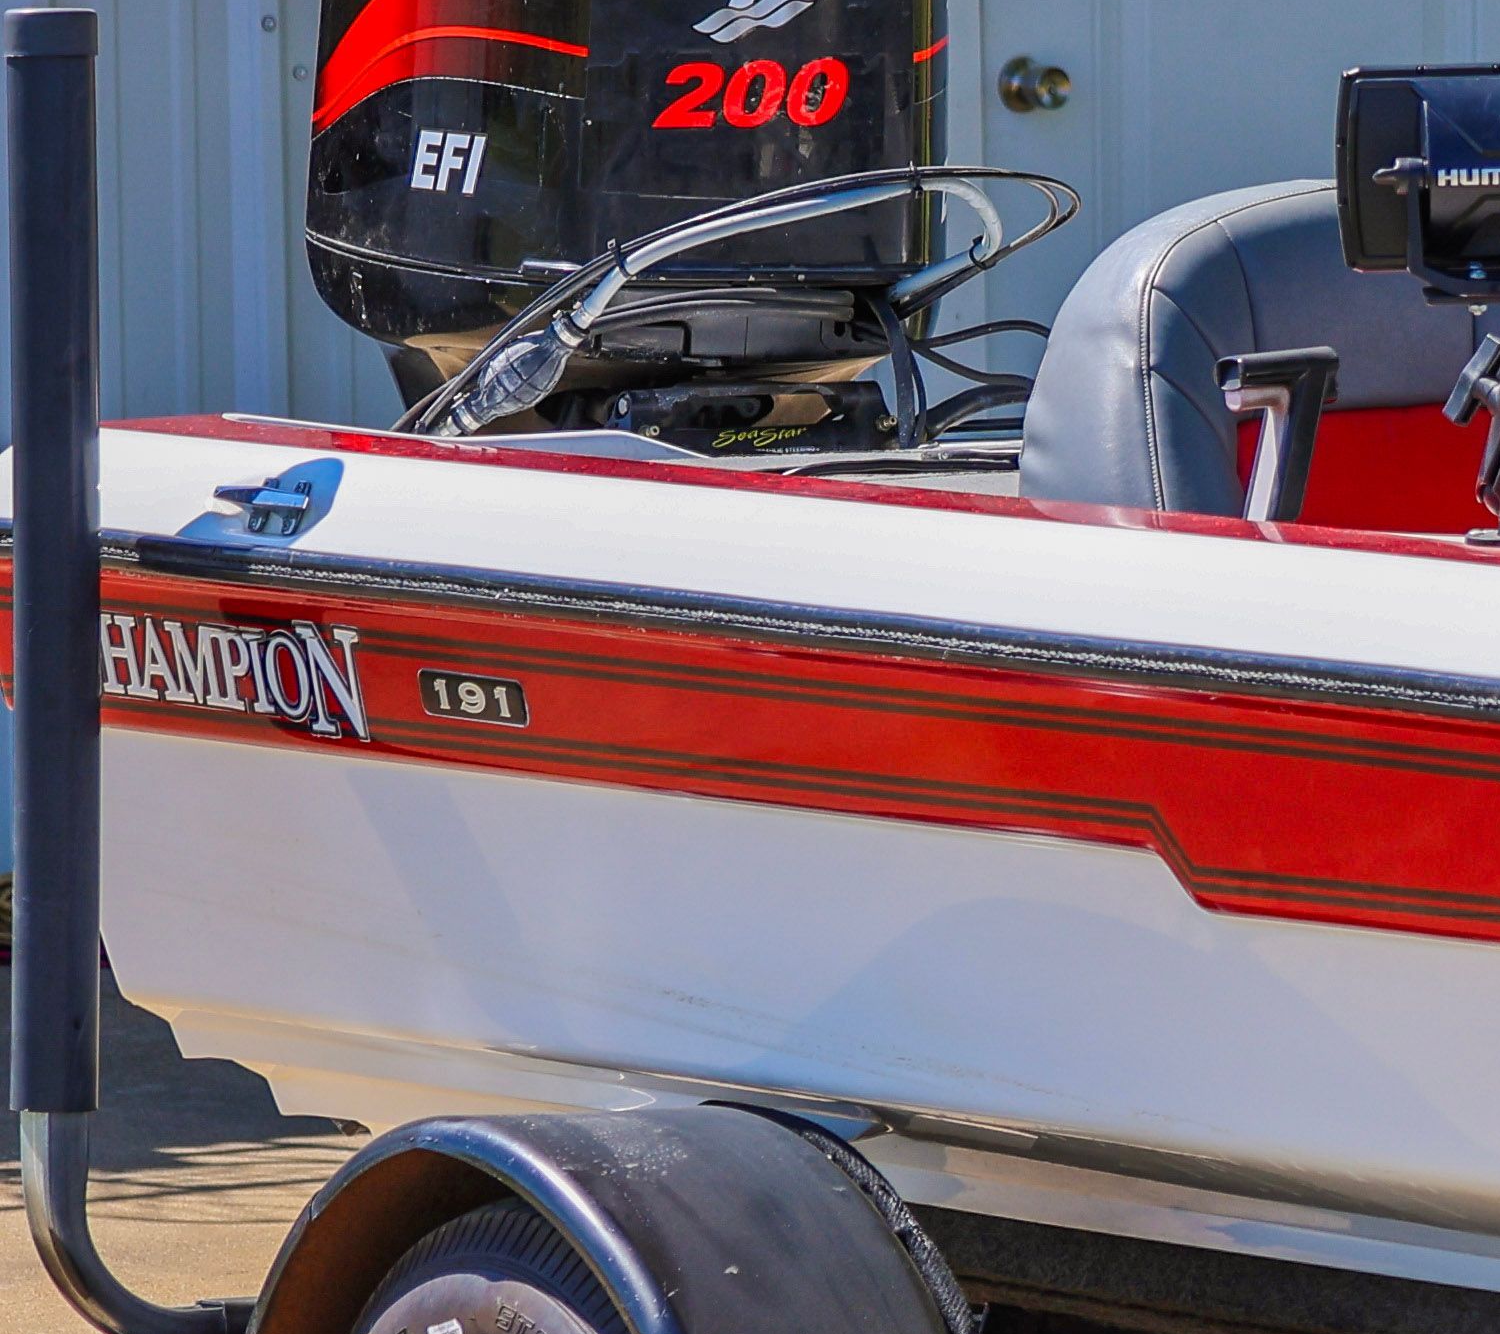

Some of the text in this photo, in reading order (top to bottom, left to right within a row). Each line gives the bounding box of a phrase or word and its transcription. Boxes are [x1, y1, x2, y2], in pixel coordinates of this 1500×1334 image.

[651, 56, 849, 129] 200
[411, 130, 486, 194] EFI
[711, 426, 809, 449] SeaStar
[100, 610, 371, 743] HAMPION
[433, 678, 512, 718] 191
